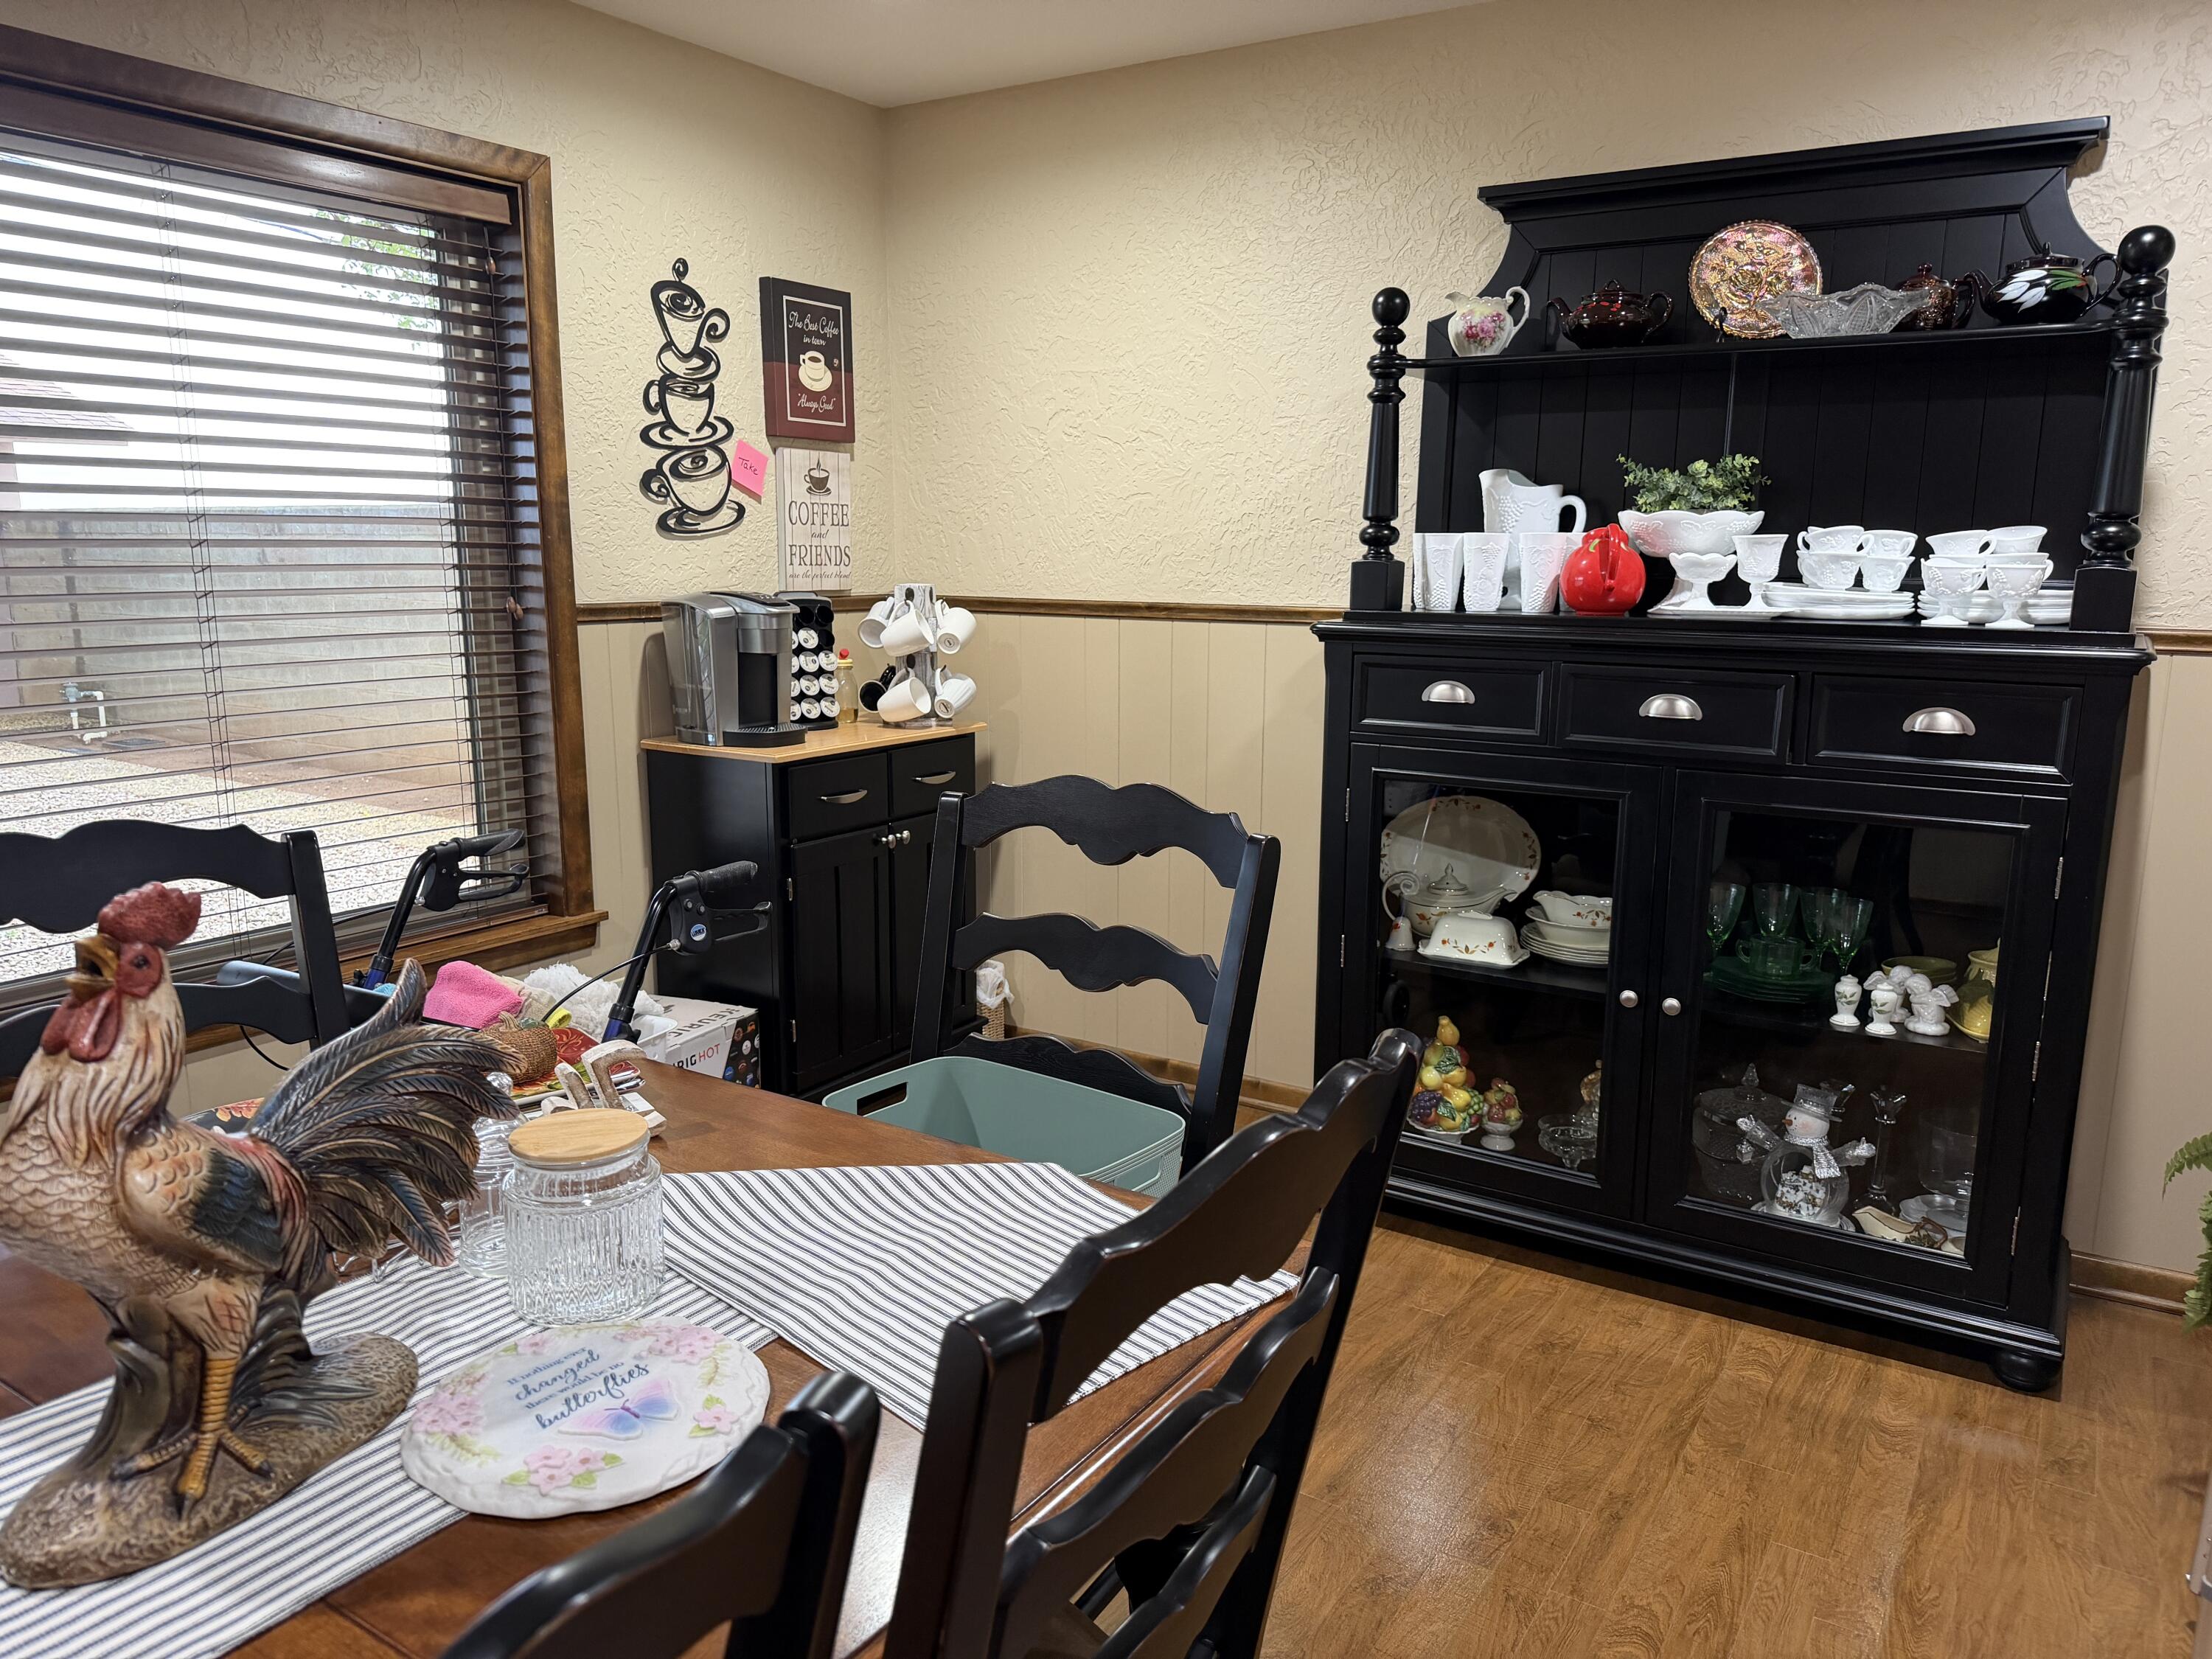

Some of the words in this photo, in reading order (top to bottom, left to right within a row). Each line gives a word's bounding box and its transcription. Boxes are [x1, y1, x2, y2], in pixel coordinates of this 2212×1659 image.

[789, 311, 803, 328] The
[804, 313, 818, 331] Best
[819, 316, 840, 338] Coffee
[804, 334, 811, 344] in
[811, 335, 827, 346] town
[738, 456, 759, 476] Take
[788, 500, 849, 527] COFFEE
[811, 529, 830, 539] and
[788, 544, 851, 567] FRIENDS
[801, 569, 810, 579] the
[811, 571, 834, 581] perfect
[834, 570, 852, 579] blend
[698, 1043, 720, 1062] HOT
[507, 1377, 518, 1385] If
[520, 1358, 565, 1380] nothing
[563, 1346, 588, 1360] ever
[515, 1349, 599, 1401] changed
[525, 1392, 558, 1409] there
[558, 1374, 595, 1394] would
[591, 1368, 608, 1378] be
[608, 1362, 625, 1371] no
[535, 1363, 650, 1430] butterflies
